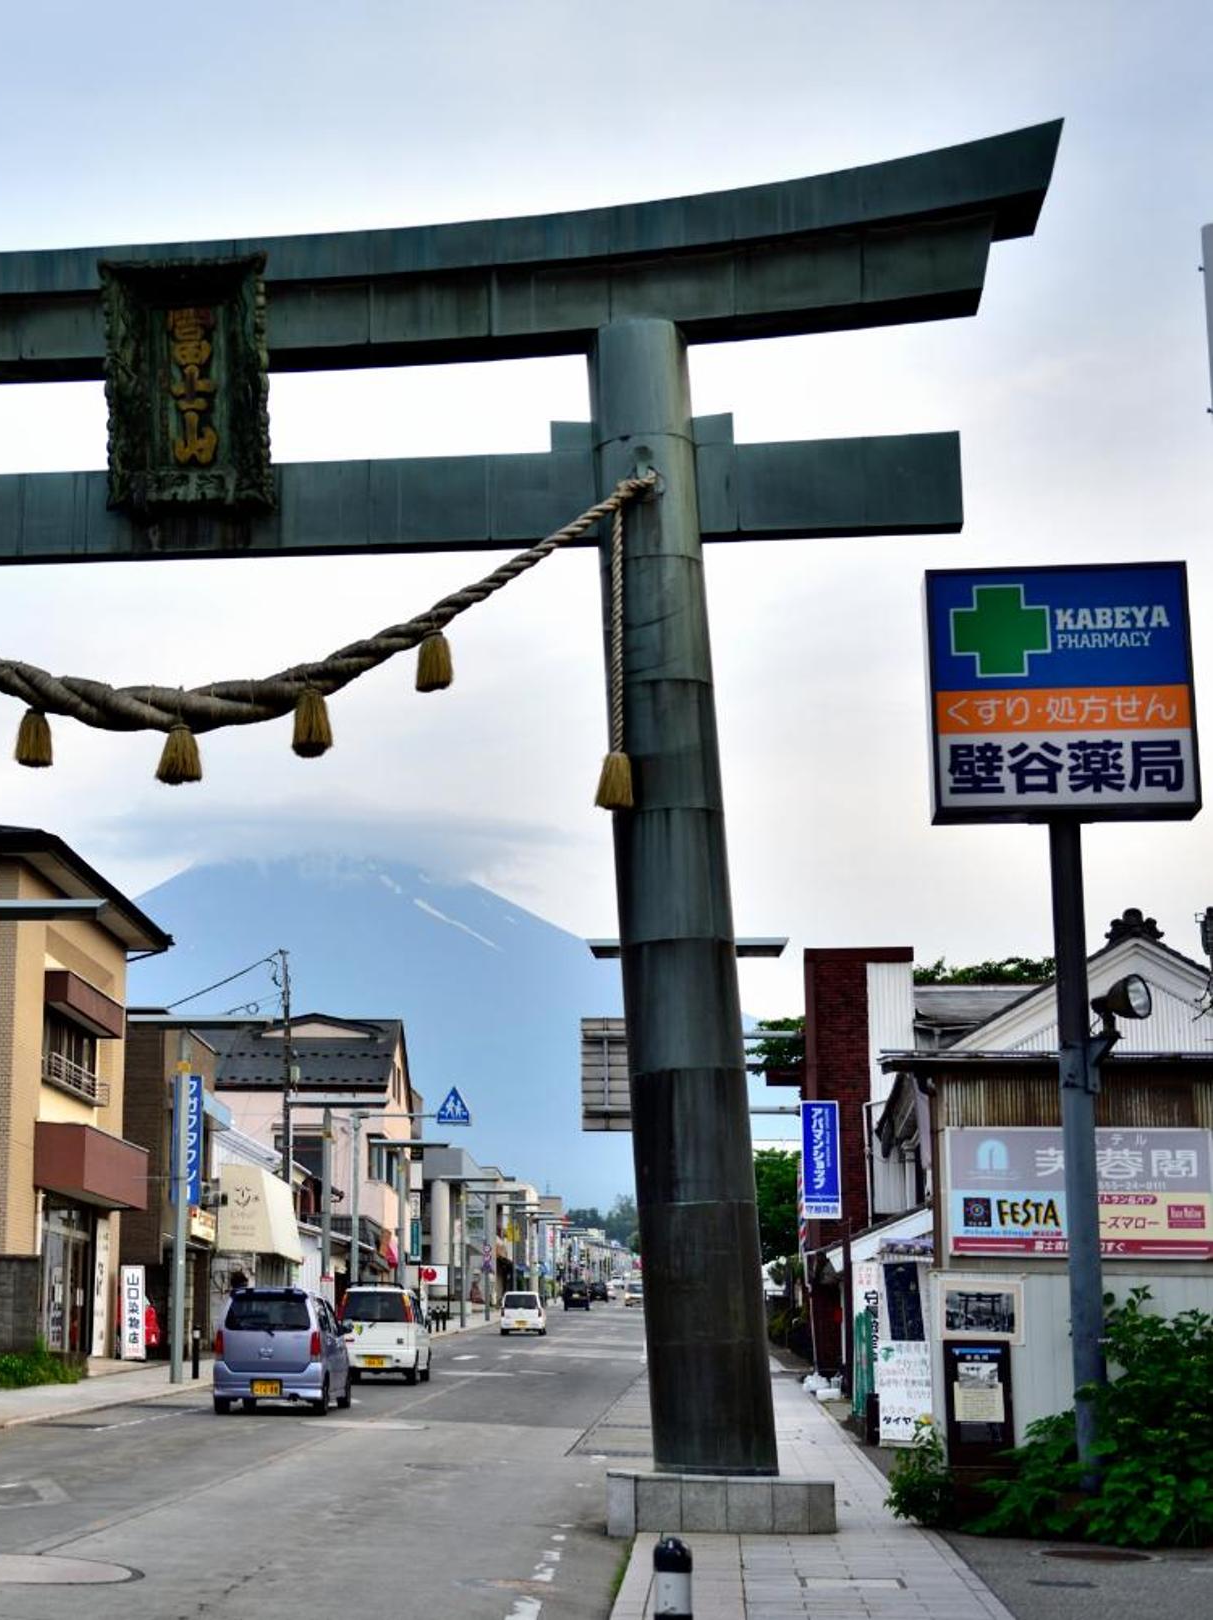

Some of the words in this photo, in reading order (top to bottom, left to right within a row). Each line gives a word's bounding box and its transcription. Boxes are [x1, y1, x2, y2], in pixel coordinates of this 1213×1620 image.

[1055, 605, 1170, 631] KABEYA
[1057, 631, 1152, 650] PHARMACY
[946, 694, 1178, 727] くすり・処方せん
[948, 739, 1185, 795] 壁谷薬局
[996, 1198, 1061, 1228] FESTA
